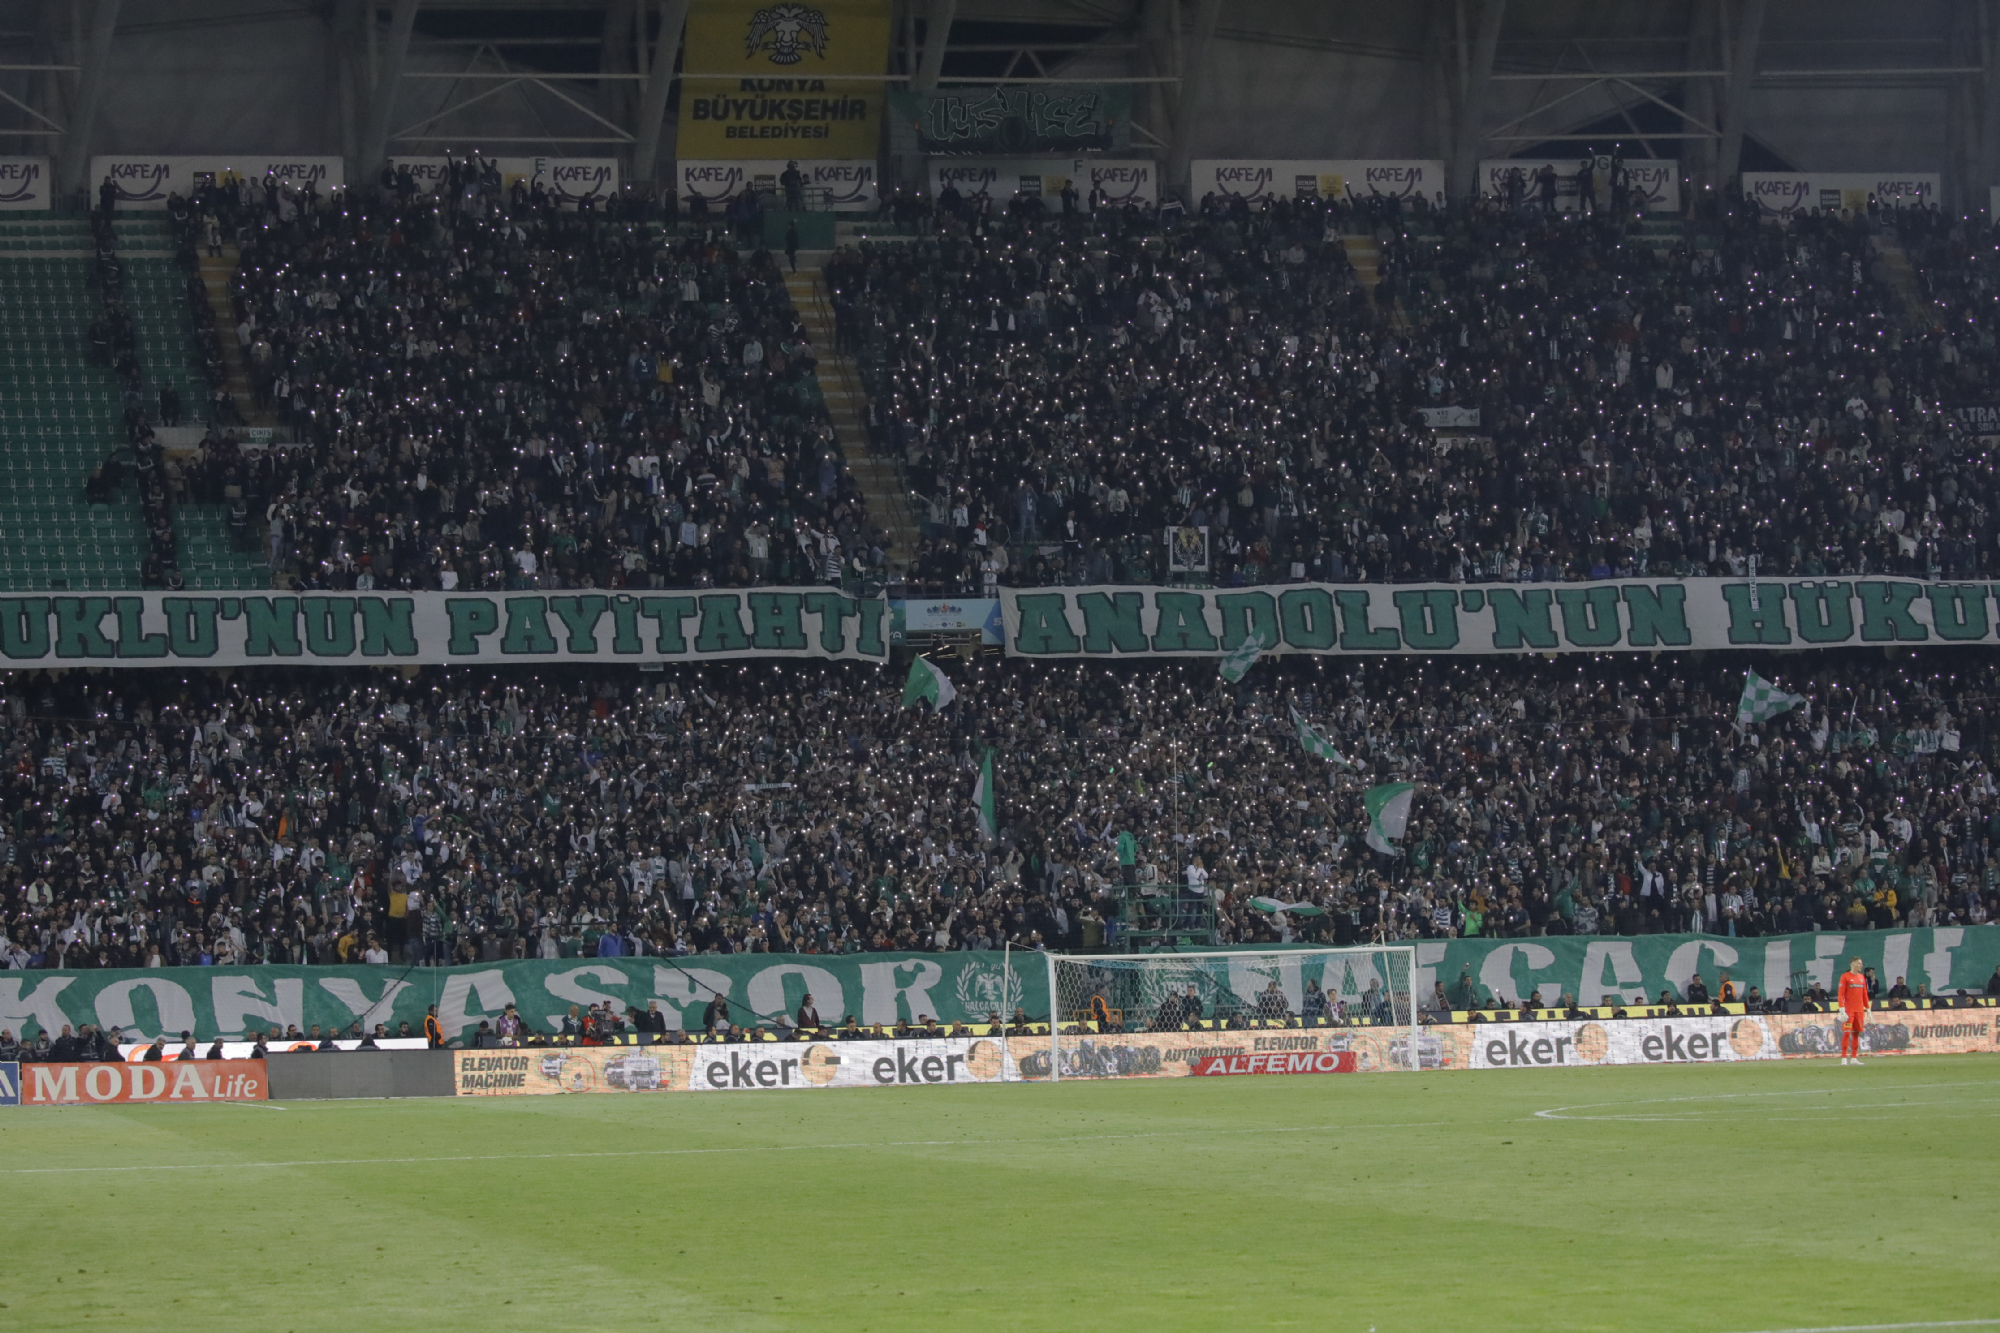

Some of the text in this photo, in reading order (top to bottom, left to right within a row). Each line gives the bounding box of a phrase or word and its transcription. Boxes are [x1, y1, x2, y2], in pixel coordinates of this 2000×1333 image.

[692, 94, 867, 124] BÜYÜKŞEHİR
[725, 122, 829, 138] BELEDİYESİ
[110, 163, 170, 179] KAFEM
[535, 158, 546, 172] E
[1074, 159, 1083, 173] F
[553, 166, 611, 181] KAFEM
[685, 167, 743, 181] KAFEM
[814, 166, 872, 181] KAFEM
[939, 167, 997, 182] KAFEM
[1216, 167, 1273, 182] KAFEM
[1366, 167, 1422, 182] KAFEM
[1754, 181, 1810, 196] KAFEM
[1956, 406, 2000, 423] LTRA
[445, 592, 887, 656] PAYİTAHTI
[1013, 584, 1692, 653] ANADOLU'NUN
[1912, 1023, 1988, 1038] AUTOMOTIVE
[1254, 1036, 1318, 1051] ELEVATOR
[1486, 1030, 1572, 1066] eker
[1641, 1025, 1727, 1061] eker
[461, 1056, 529, 1072] ELEVATOR
[706, 1051, 798, 1088] eker
[872, 1047, 964, 1084] eker
[1204, 1053, 1340, 1075] ALFEMO
[31, 1064, 209, 1101] MODA
[213, 1070, 259, 1098] Life
[461, 1073, 526, 1089] MACHINE
